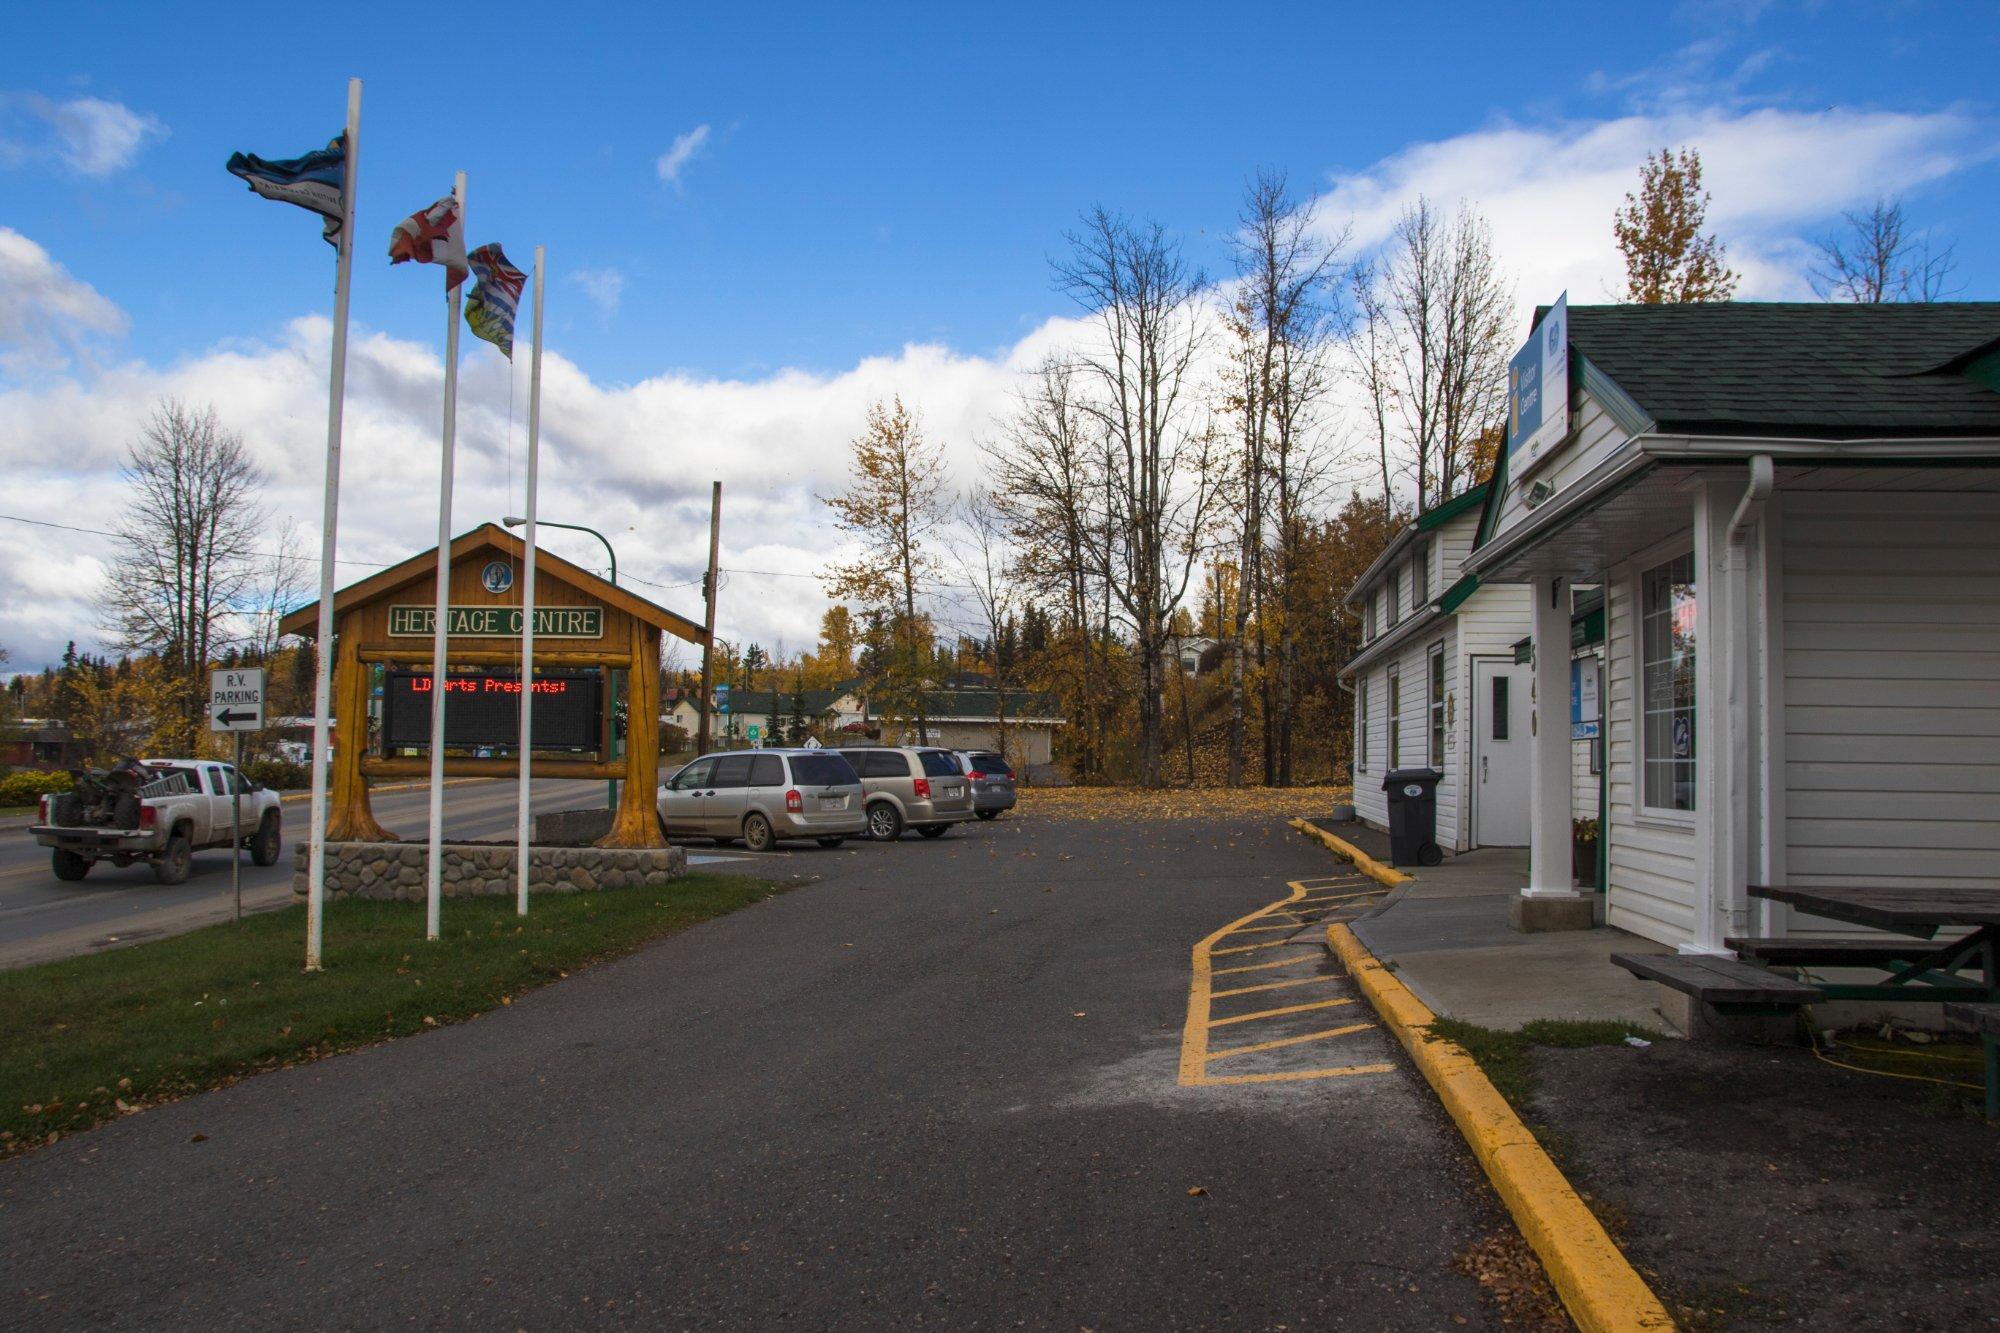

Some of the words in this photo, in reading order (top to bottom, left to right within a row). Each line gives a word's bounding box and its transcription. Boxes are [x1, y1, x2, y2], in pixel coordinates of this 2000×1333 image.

[1521, 388, 1537, 416] Centre
[394, 610, 498, 632] HERTAGE
[227, 674, 246, 687] R.V.
[412, 678, 431, 691] LD
[485, 680, 566, 693] Presnts:
[214, 690, 259, 703] PARKING
